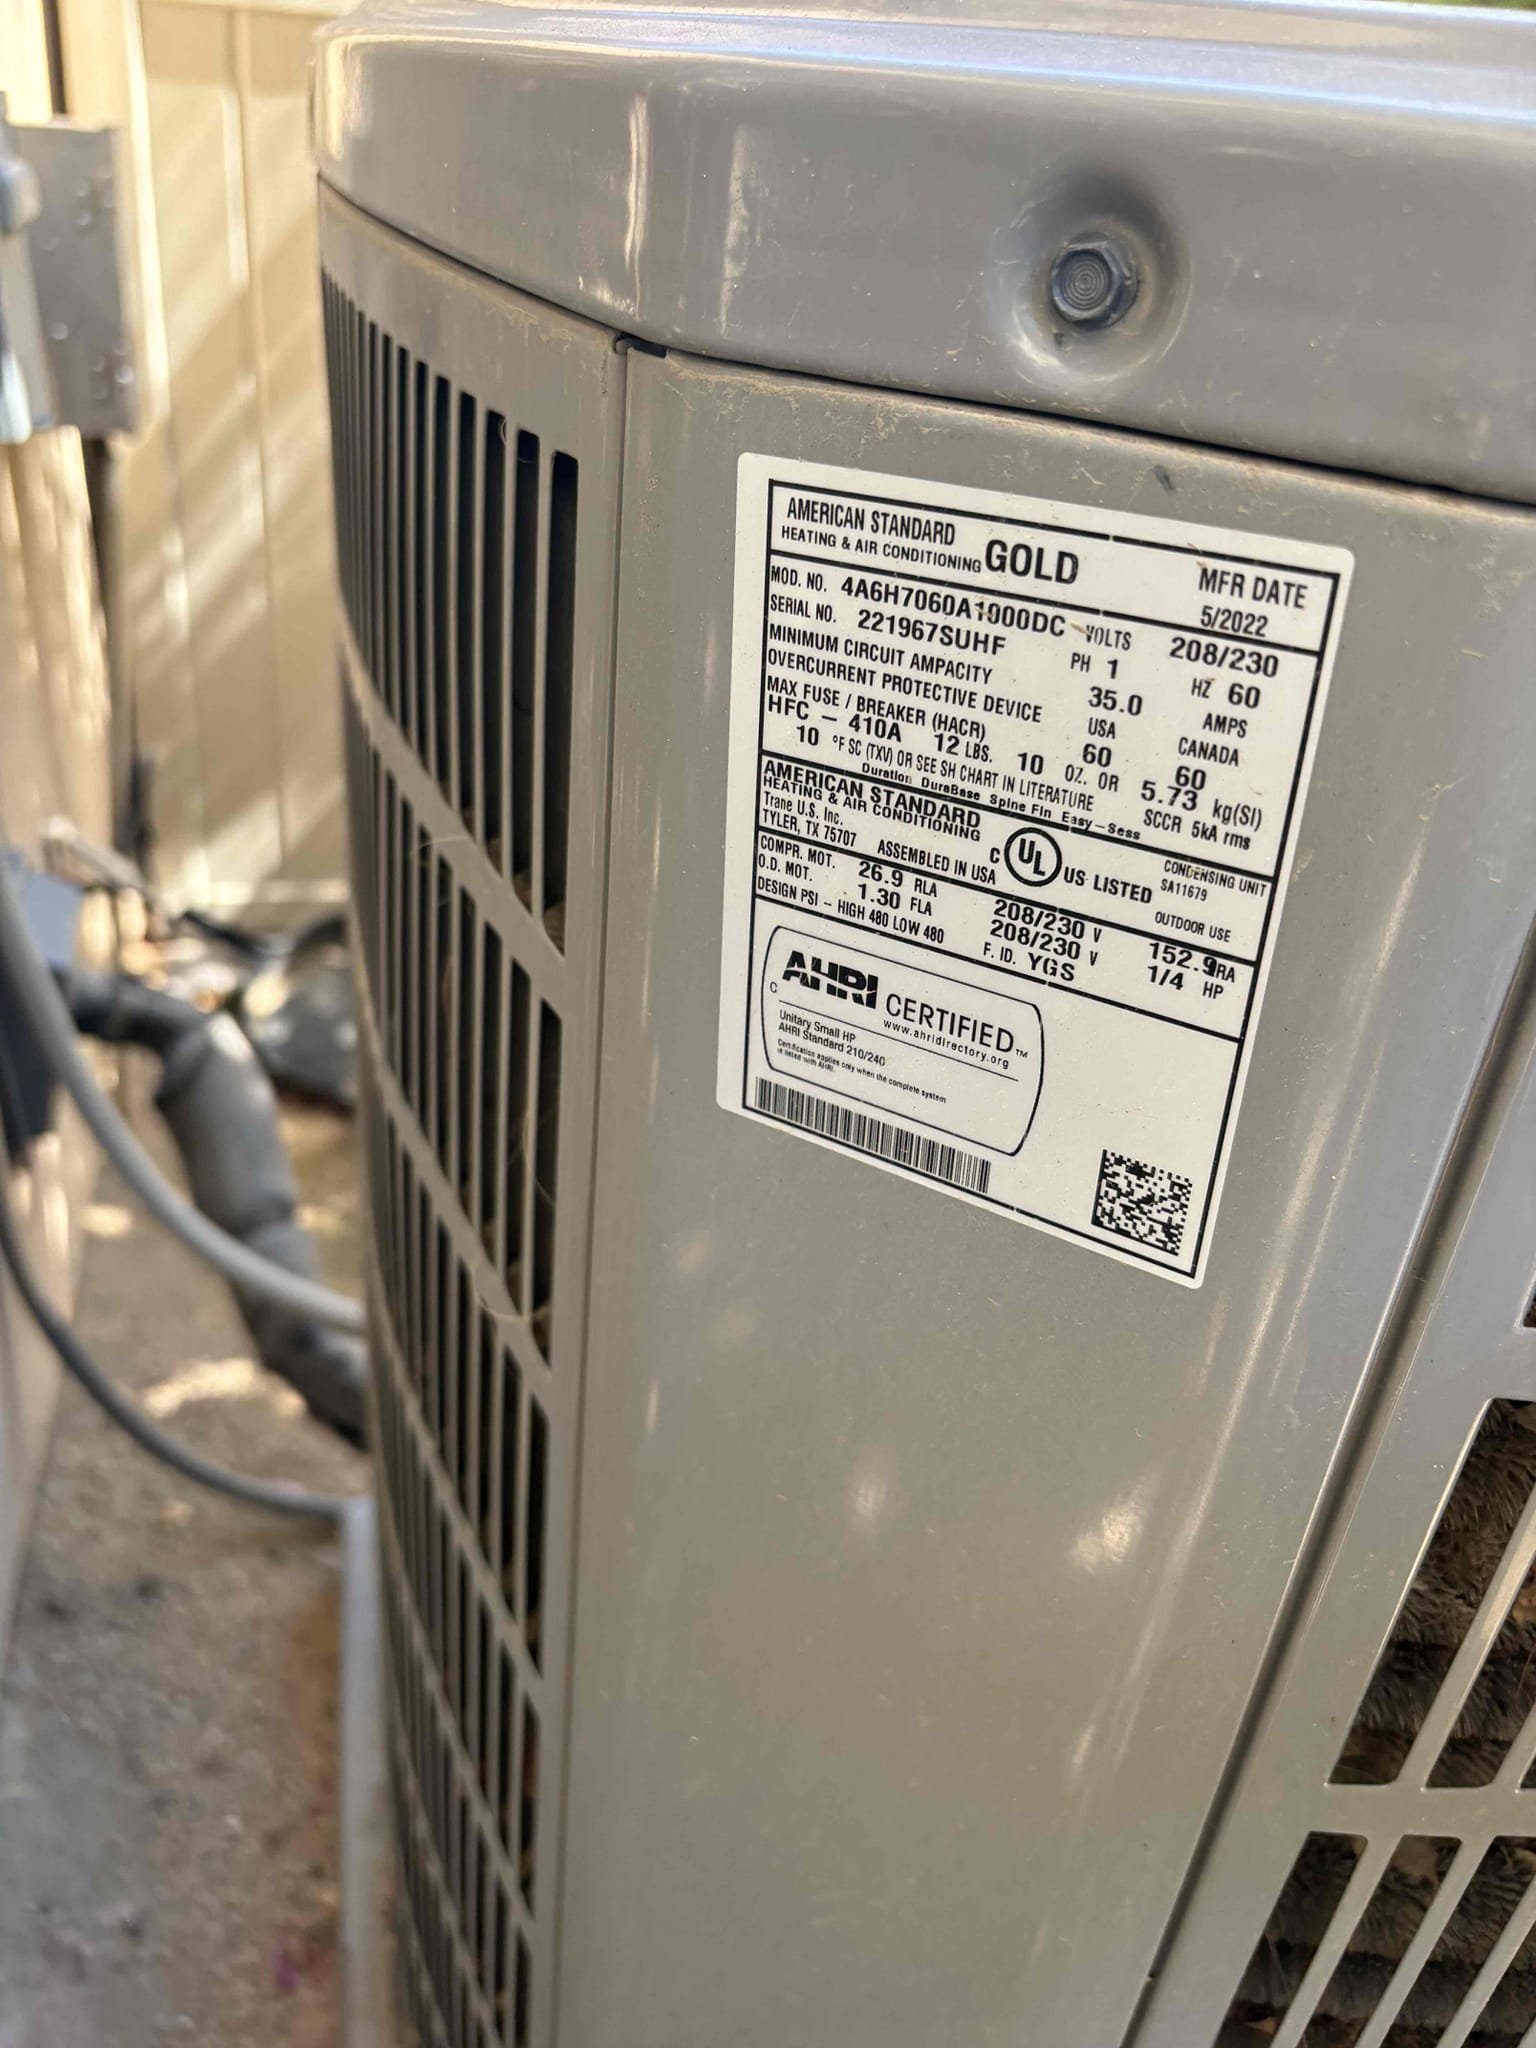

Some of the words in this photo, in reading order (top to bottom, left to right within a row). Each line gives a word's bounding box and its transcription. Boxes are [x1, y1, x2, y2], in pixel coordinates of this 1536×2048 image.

[781, 525, 836, 547] HEATING
[842, 536, 850, 550] &
[855, 539, 877, 555] AIR
[883, 543, 982, 573] CONDITIONING
[787, 497, 865, 530] AMERICAN
[871, 510, 955, 546] STANDARD
[985, 539, 1079, 584] GOLD
[1198, 567, 1245, 598] MFR
[1252, 576, 1308, 609] DATE
[770, 593, 811, 618] SERIAL
[816, 604, 836, 623] NO.
[858, 609, 1006, 655] 221967SUHF
[1070, 652, 1091, 672] PH
[1107, 659, 1118, 679] 1
[1191, 678, 1212, 699] HZ
[1228, 683, 1260, 708] 60
[771, 565, 801, 587] MOD.
[807, 572, 827, 592] NO.
[841, 577, 1066, 637] 4A6H7060A1000DC
[1086, 624, 1132, 651] VOLTS
[1170, 636, 1279, 678] 208/230
[1201, 605, 1268, 637] 5/2022
[768, 648, 876, 686] OVERCURRENT
[882, 673, 977, 709] PROTECTIVE
[983, 695, 1042, 723] DEVICE
[1088, 717, 1116, 740] USA
[1178, 736, 1239, 766] CANADA
[769, 623, 838, 653] MINIMUM
[844, 639, 905, 666] CIRCUIT
[910, 653, 992, 685] AMPACITY
[1088, 686, 1142, 716] 35.0
[1202, 713, 1248, 738] AMPS
[767, 675, 798, 697] MAX
[803, 684, 840, 706] FUSE
[845, 694, 852, 709] /
[856, 696, 926, 726] BREAKER
[932, 712, 986, 742] (HACR)
[1082, 743, 1112, 768] 60
[1175, 765, 1207, 790] 60
[768, 695, 809, 720] HFC
[849, 714, 901, 742] 410A
[934, 733, 960, 756] 12
[965, 741, 992, 763] LBS.
[1017, 752, 1044, 775] 10
[1098, 772, 1119, 792] OR
[1141, 780, 1198, 812] 5.73
[1212, 799, 1262, 832] kg(SI)
[796, 725, 819, 746] 10
[848, 739, 862, 756] SC
[866, 743, 893, 767] (TXV)
[897, 750, 913, 768] OR
[916, 754, 937, 774] SEE
[940, 760, 956, 779] SH
[960, 764, 999, 789] CHART
[1002, 774, 1016, 793] IN
[1019, 778, 1094, 812] LITERATURE
[1143, 809, 1182, 833] SCCR
[1191, 821, 1217, 842] 5kA
[1223, 832, 1251, 851] rms
[921, 777, 981, 801] DuraBase
[763, 776, 822, 800] HEATING
[828, 792, 838, 805] &
[843, 796, 867, 812] AIR
[872, 804, 981, 842] CONDITIONING
[764, 760, 864, 799] AMERICAN
[870, 786, 981, 828] STANDARD
[764, 791, 793, 812] Trane
[797, 799, 818, 819] U.S.
[824, 807, 843, 826] Inc.
[763, 809, 800, 834] TYLER,
[806, 820, 819, 838] TX
[824, 825, 857, 847] 75707
[877, 839, 949, 871] ASSEMBLED
[954, 859, 967, 877] IN
[971, 864, 996, 885] USA
[1018, 838, 1046, 877] UL
[1063, 867, 1085, 886] US
[1093, 874, 1152, 904] LISTED
[761, 835, 803, 859] COMPR.
[808, 848, 835, 869] MOT.
[858, 861, 903, 887] 26.9
[914, 878, 937, 897] RLA
[994, 899, 1085, 939] 208/230
[1093, 927, 1102, 943] V
[1160, 879, 1207, 901] SA11679
[1164, 859, 1235, 889] CONDENSING
[1239, 879, 1267, 897] UNIT
[757, 876, 797, 900] DESIGN
[801, 889, 818, 906] PSI
[838, 899, 864, 920] HIGH
[869, 909, 889, 927] 480
[892, 916, 920, 936] LOW
[923, 927, 944, 944] 480
[983, 942, 994, 958] F.
[1000, 947, 1016, 965] ID.
[1028, 952, 1075, 981] YGS
[758, 853, 780, 872] O.D.
[785, 861, 812, 881] MOT.
[858, 884, 901, 910] 1.30
[910, 897, 932, 916] FLA
[990, 919, 1081, 960] 208/230
[1089, 951, 1098, 966] V
[1147, 965, 1184, 991] 1/4
[1202, 981, 1224, 1000] HP
[1155, 911, 1205, 936] OUTDOOR
[1209, 926, 1231, 943] USE
[782, 950, 879, 1009] AHRI
[778, 1022, 800, 1037] AHRI
[803, 1030, 844, 1052] Standard
[846, 1045, 886, 1067] 210/240
[779, 1009, 812, 1030] Unitary
[814, 1021, 840, 1037] Small
[842, 1032, 856, 1043] HP
[883, 1019, 1009, 1069] www.ahridirectory.org
[886, 993, 1014, 1053] CERTIFIED
[876, 1073, 887, 1082] the
